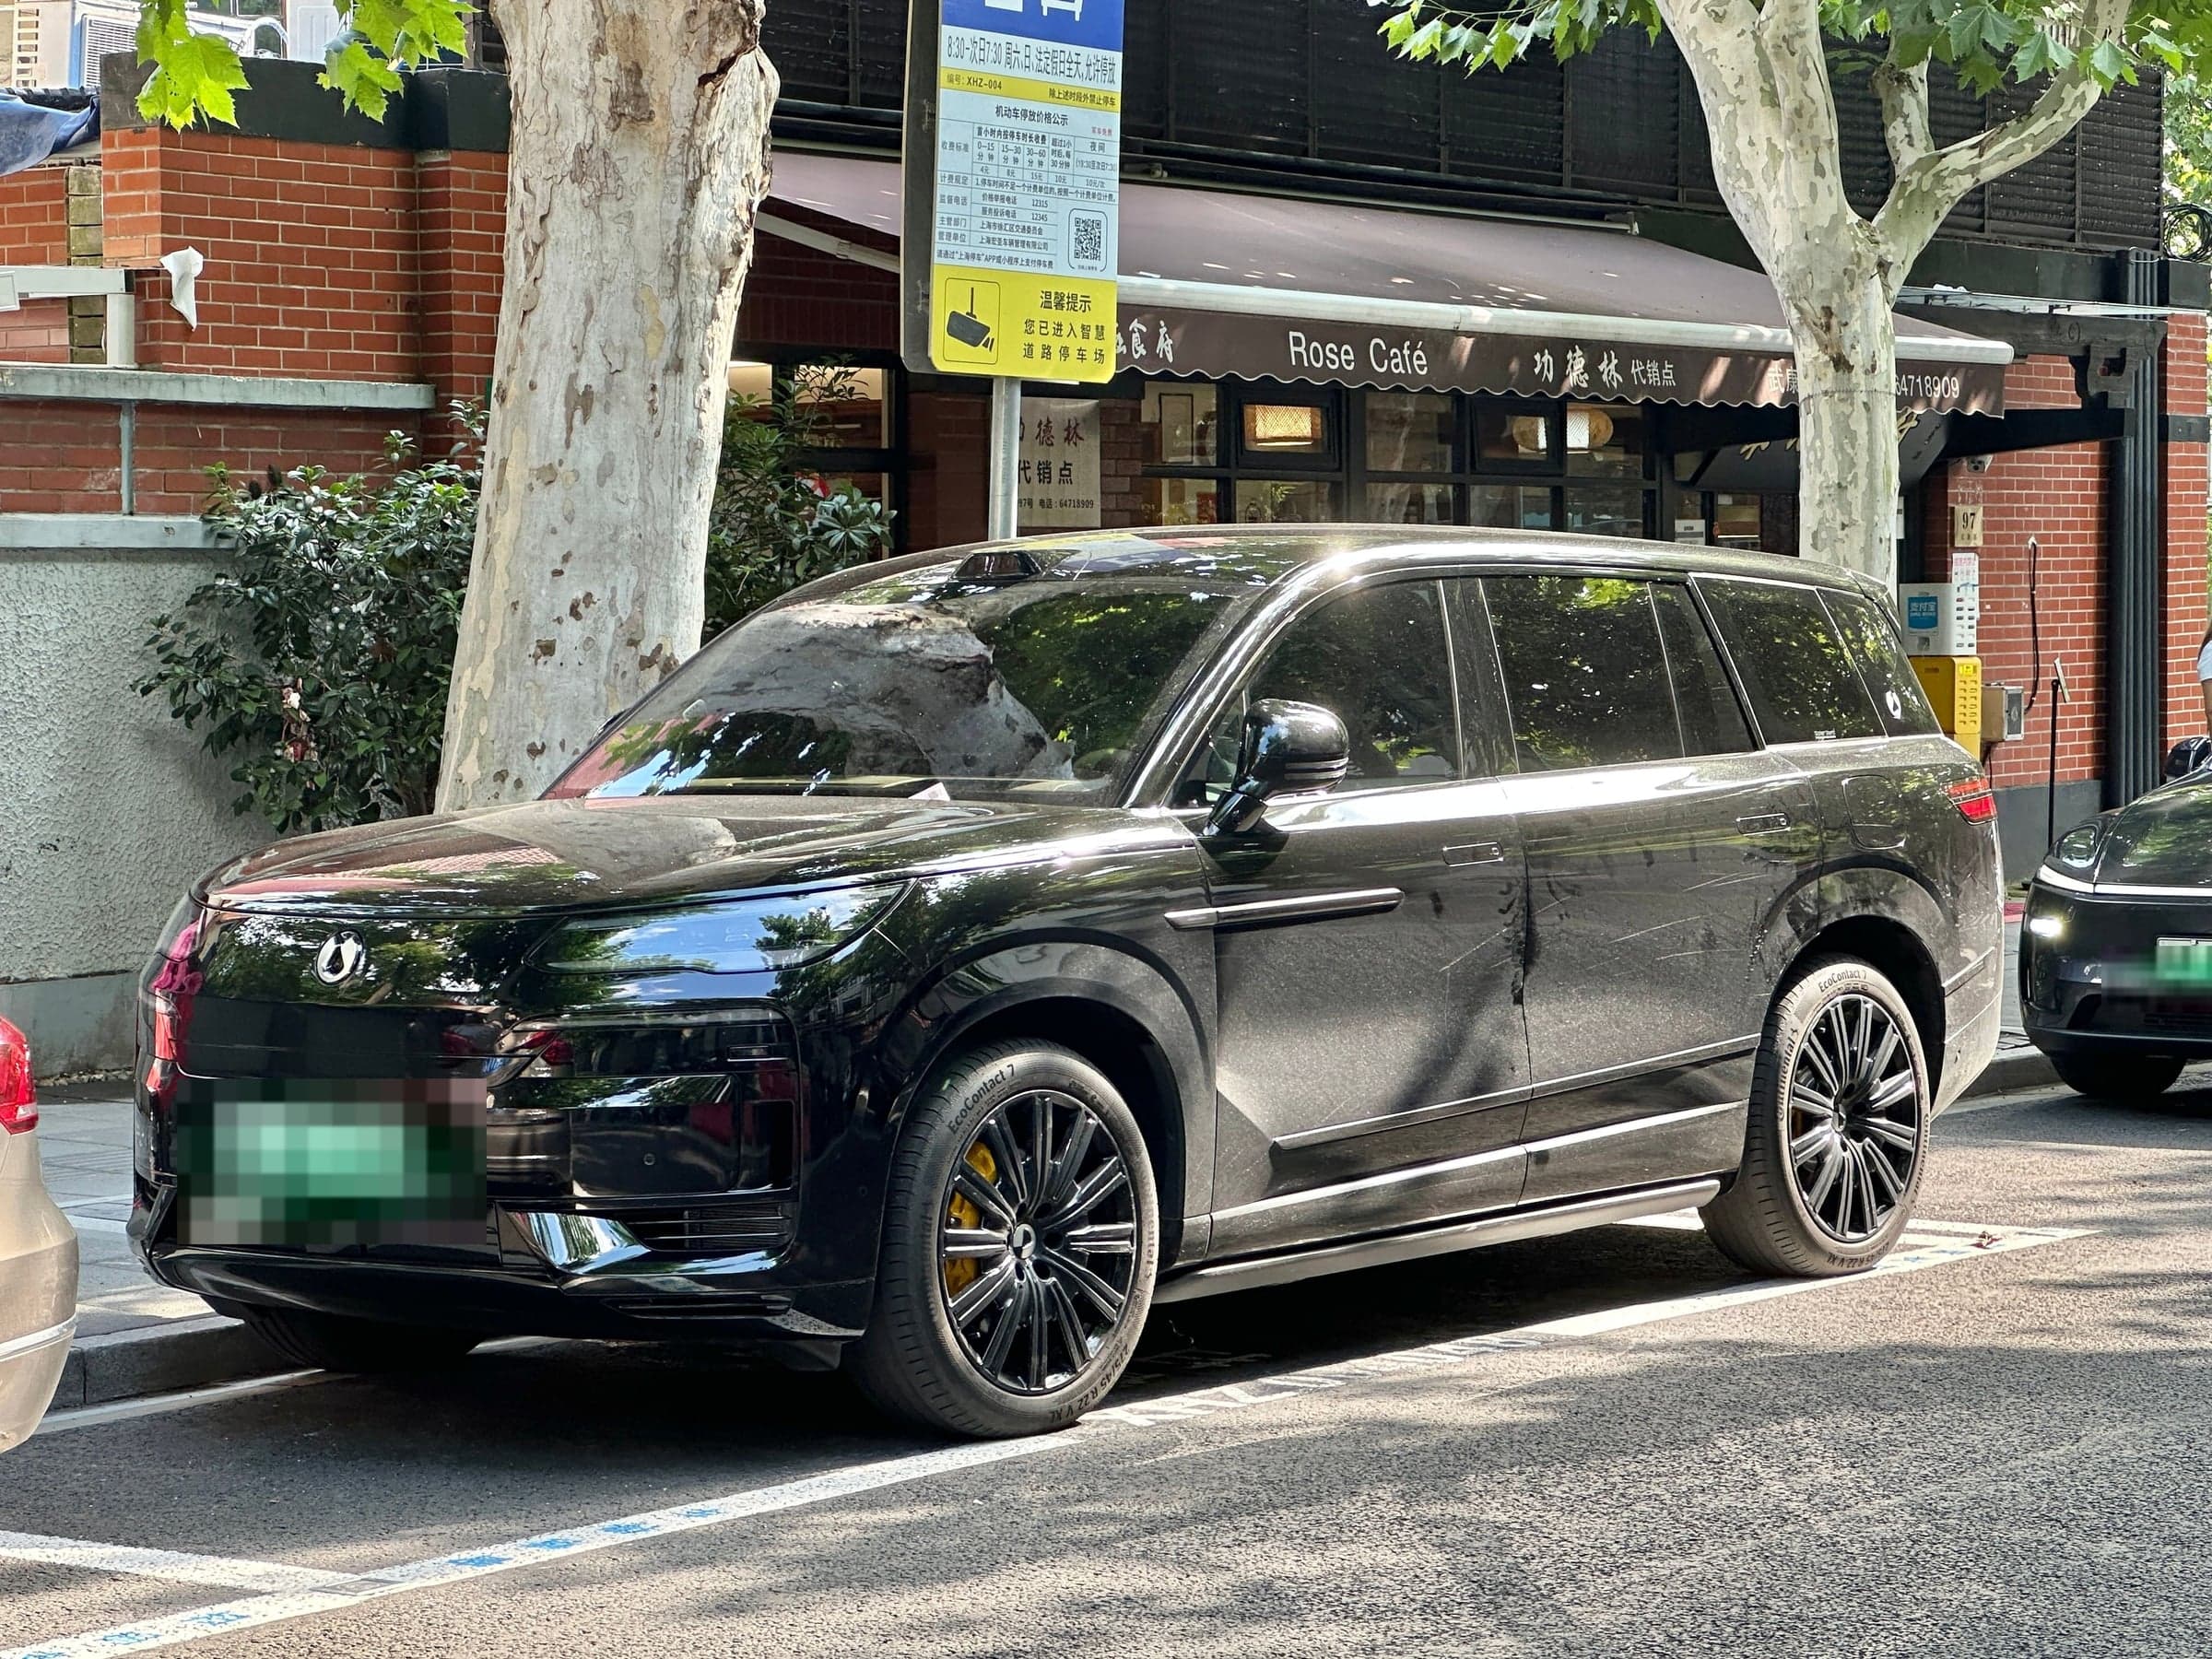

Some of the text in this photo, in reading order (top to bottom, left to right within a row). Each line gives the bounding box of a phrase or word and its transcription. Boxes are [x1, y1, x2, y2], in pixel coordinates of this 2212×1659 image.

[1048, 88, 1116, 106] 除上述时段外禁止停车
[994, 103, 1069, 126] 机动车停放价格公示
[1031, 198, 1048, 208] 12315
[1031, 213, 1048, 222] 12345
[1040, 290, 1091, 313] 温馨提示
[1024, 319, 1105, 341] 您已进入智慧
[1023, 342, 1105, 365] 道路停车场
[1288, 330, 1428, 375] Rose Café
[1534, 344, 1677, 390] 功德林 代销点
[1961, 512, 1976, 530] 97
[1818, 969, 1861, 993] EcoContact
[947, 1064, 1015, 1135] EcoContact 7
